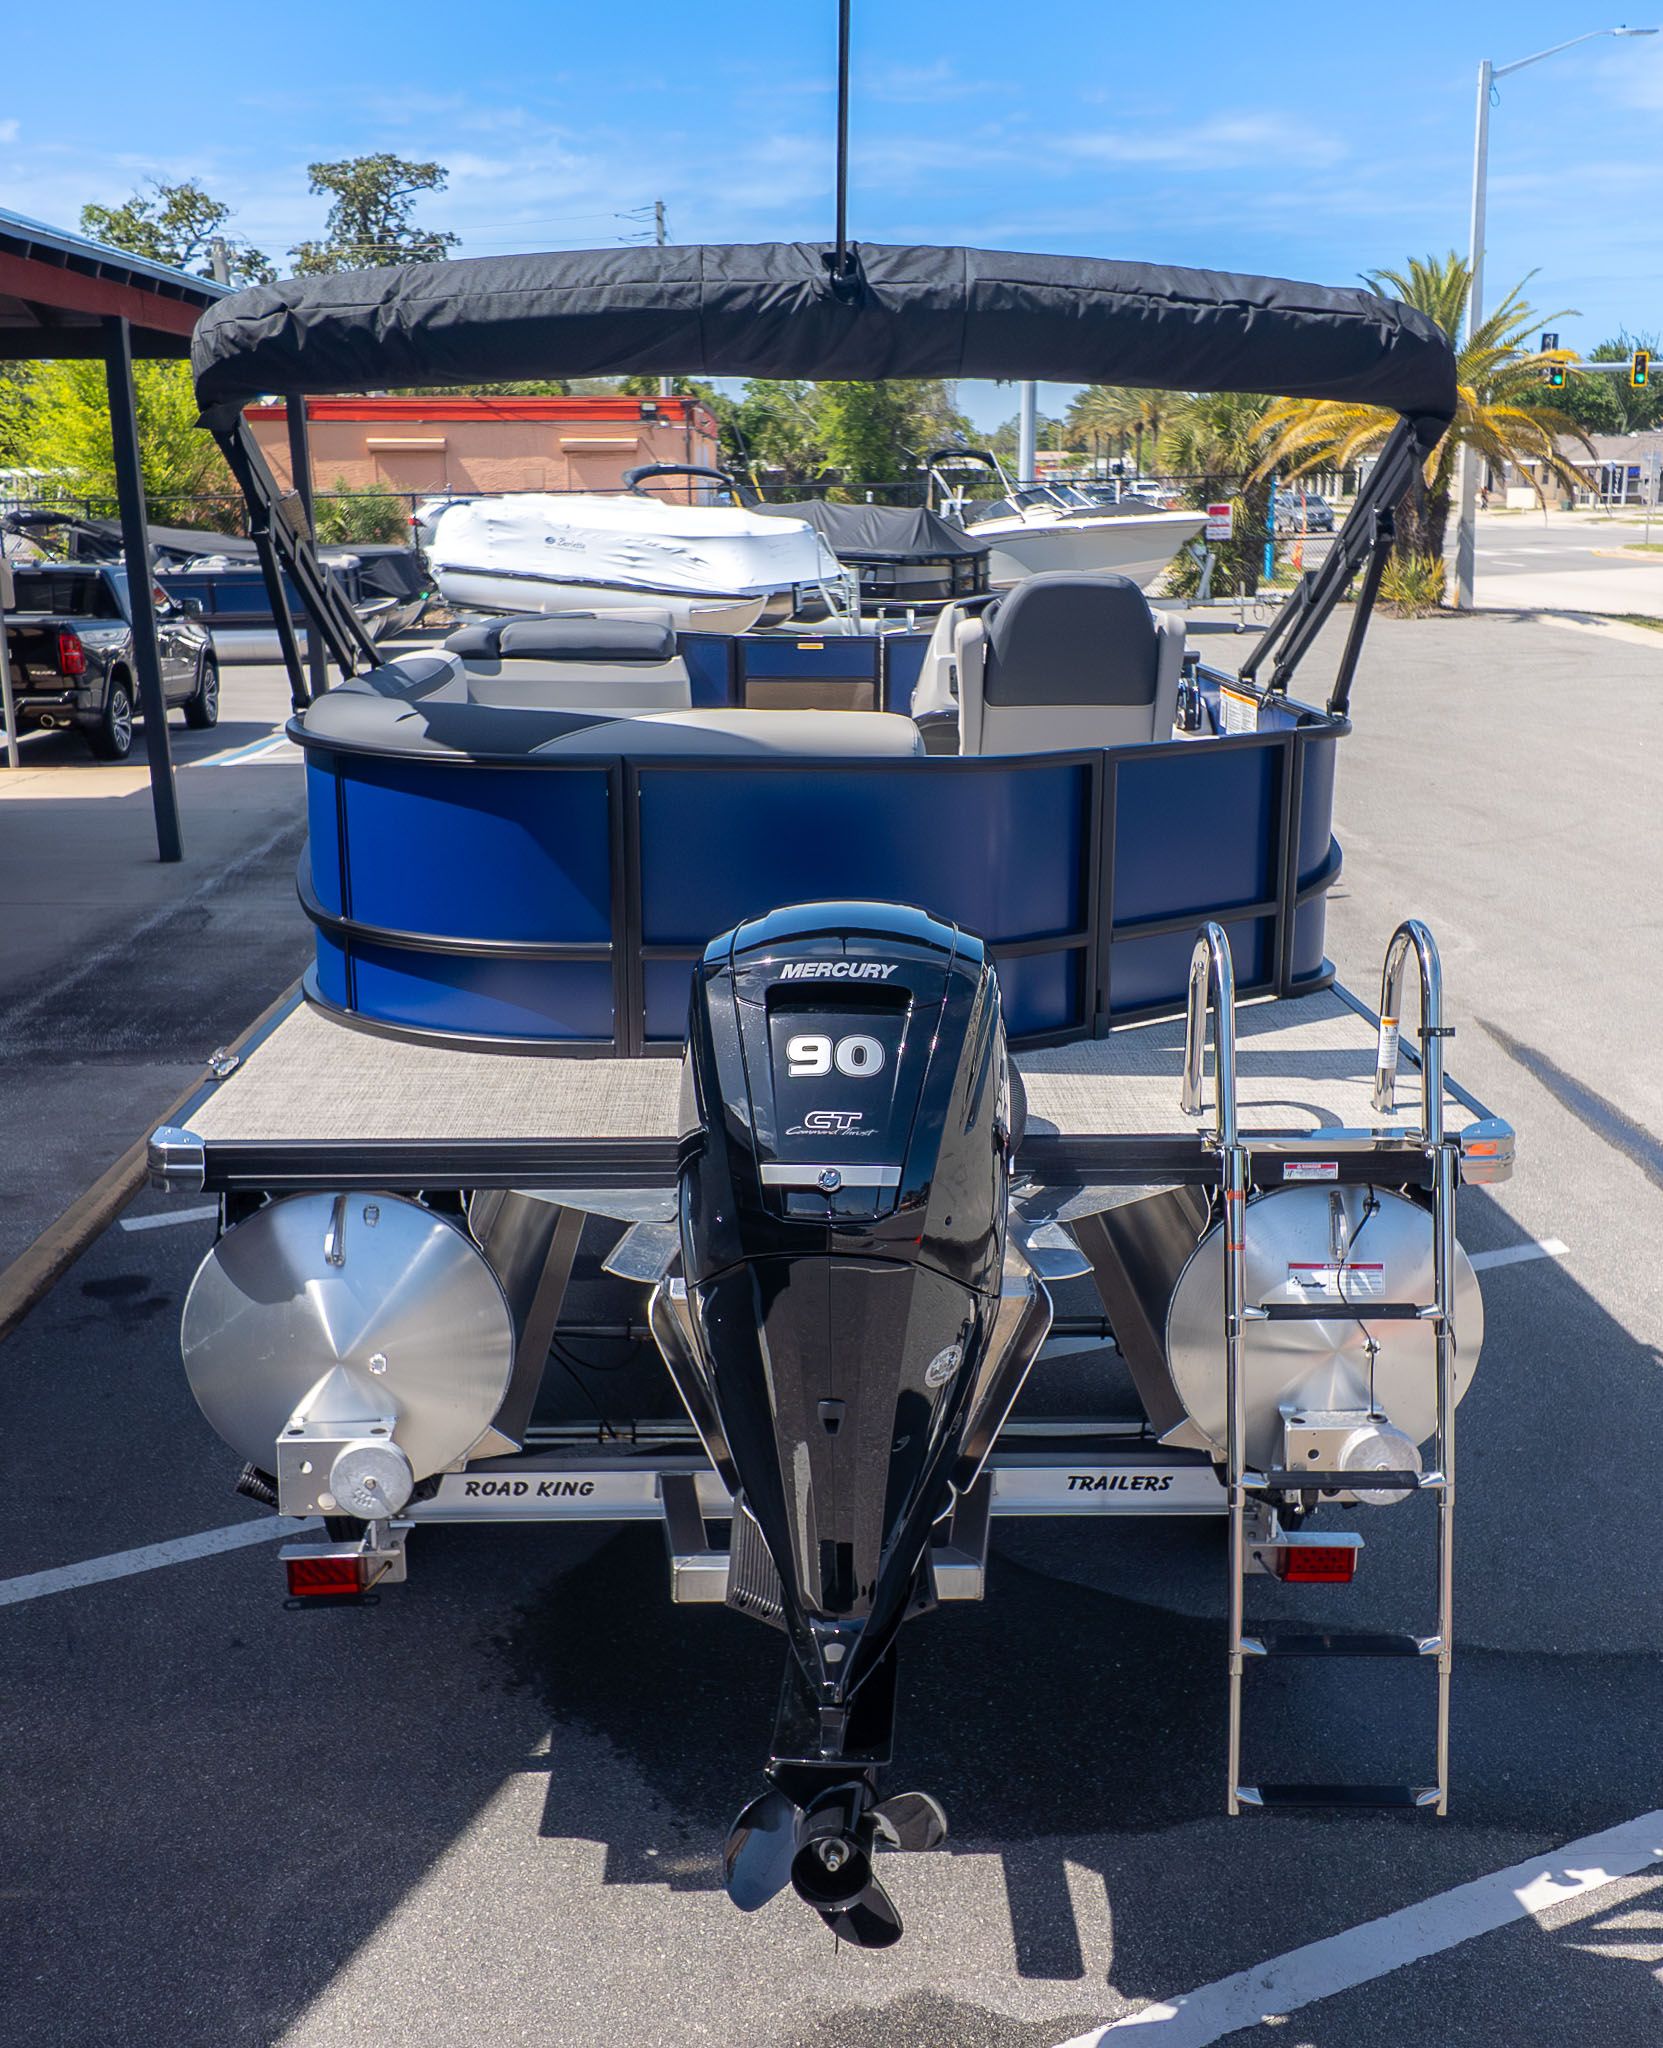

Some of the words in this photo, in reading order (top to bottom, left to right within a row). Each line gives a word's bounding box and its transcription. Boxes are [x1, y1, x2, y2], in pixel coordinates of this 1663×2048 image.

[779, 962, 899, 980] MERCURY
[786, 1033, 886, 1078] 90
[804, 1110, 863, 1129] CT
[785, 1125, 839, 1136] Command
[841, 1126, 879, 1137] Thrust
[465, 1481, 529, 1497] ROAD
[536, 1481, 595, 1497] KING
[1067, 1475, 1174, 1491] TRAILERS
